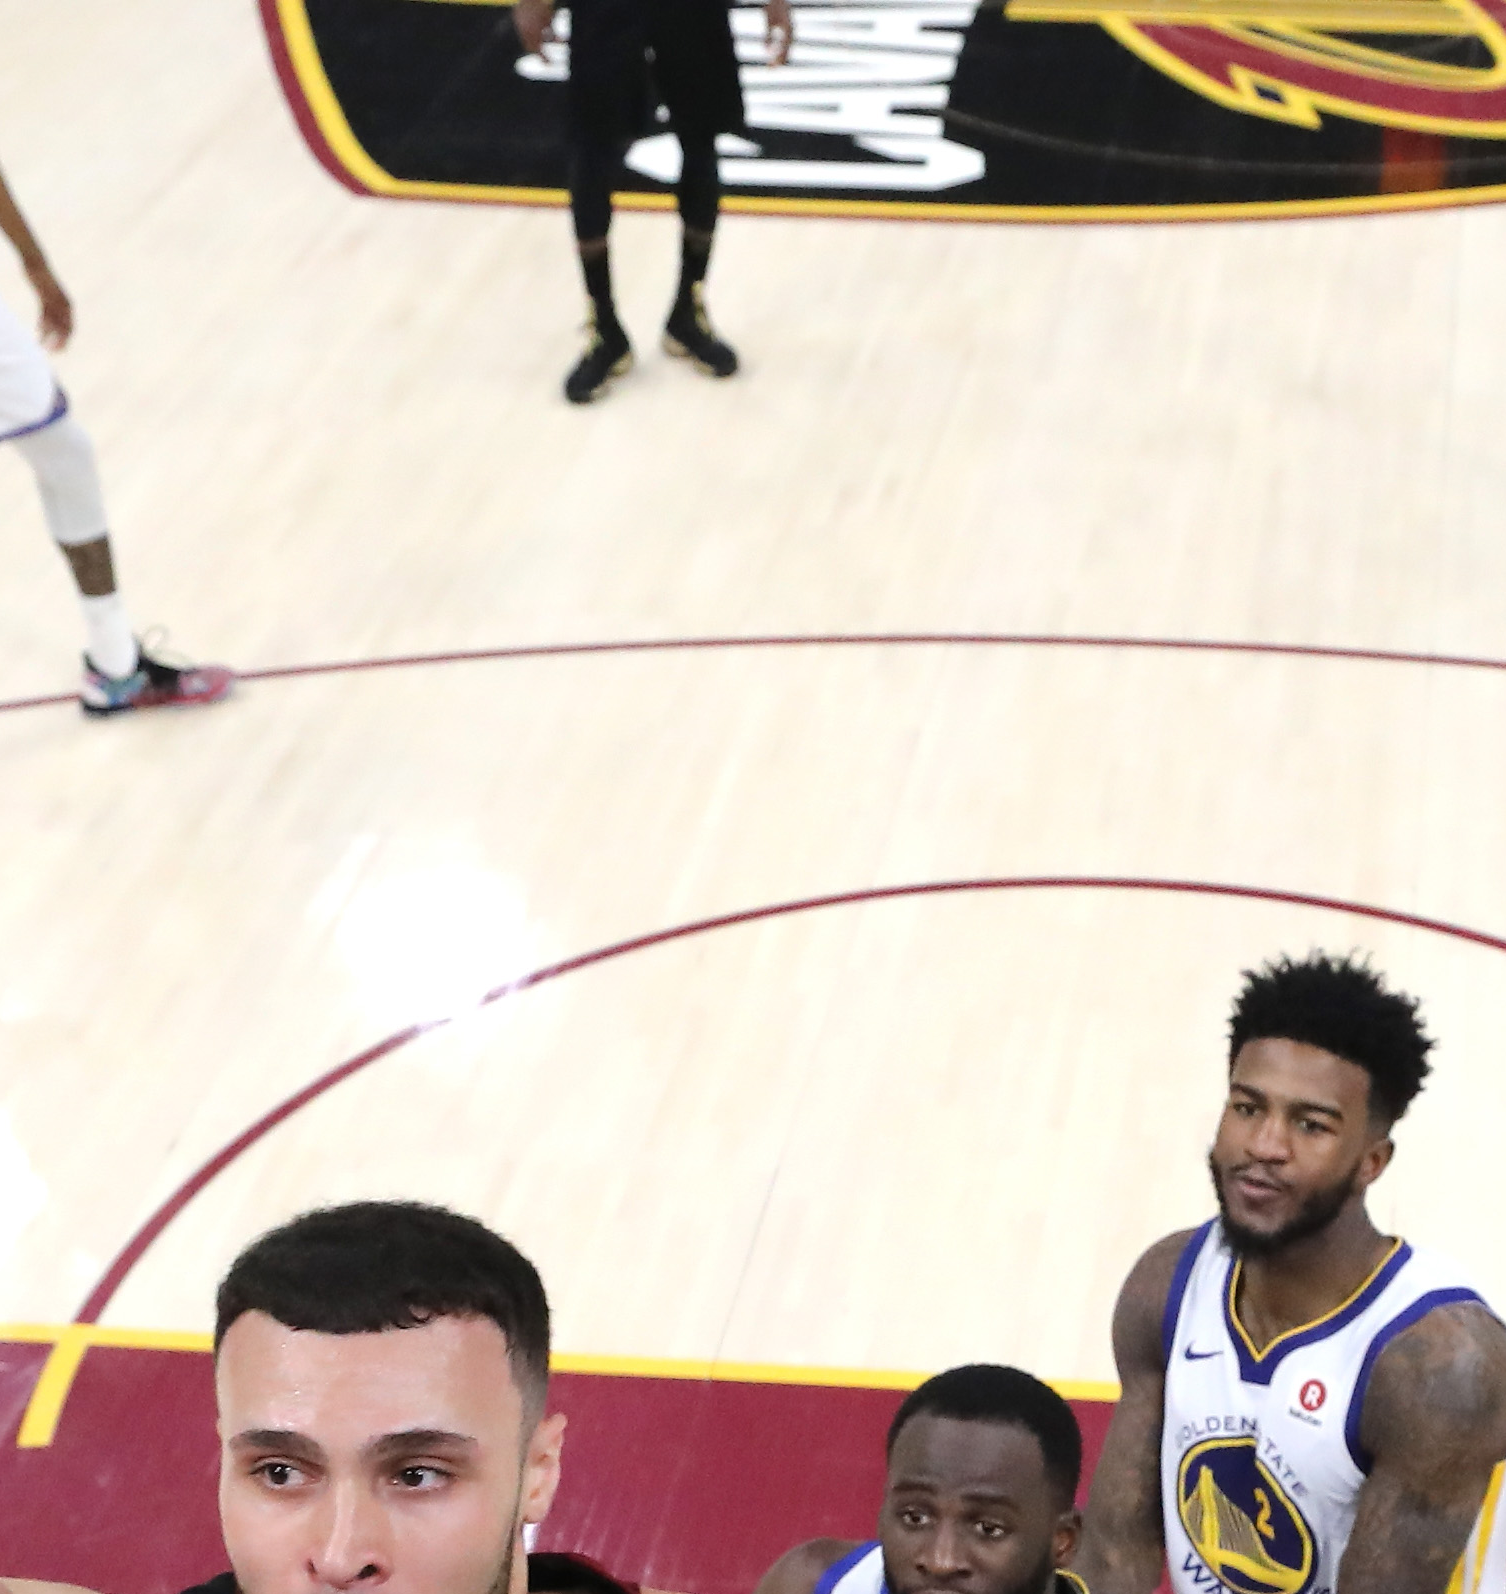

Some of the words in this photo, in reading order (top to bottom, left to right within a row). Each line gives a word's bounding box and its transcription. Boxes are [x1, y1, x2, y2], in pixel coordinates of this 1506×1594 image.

[1302, 1381, 1324, 1409] R
[1263, 1437, 1309, 1497] TATE
[1254, 1487, 1276, 1540] 2
